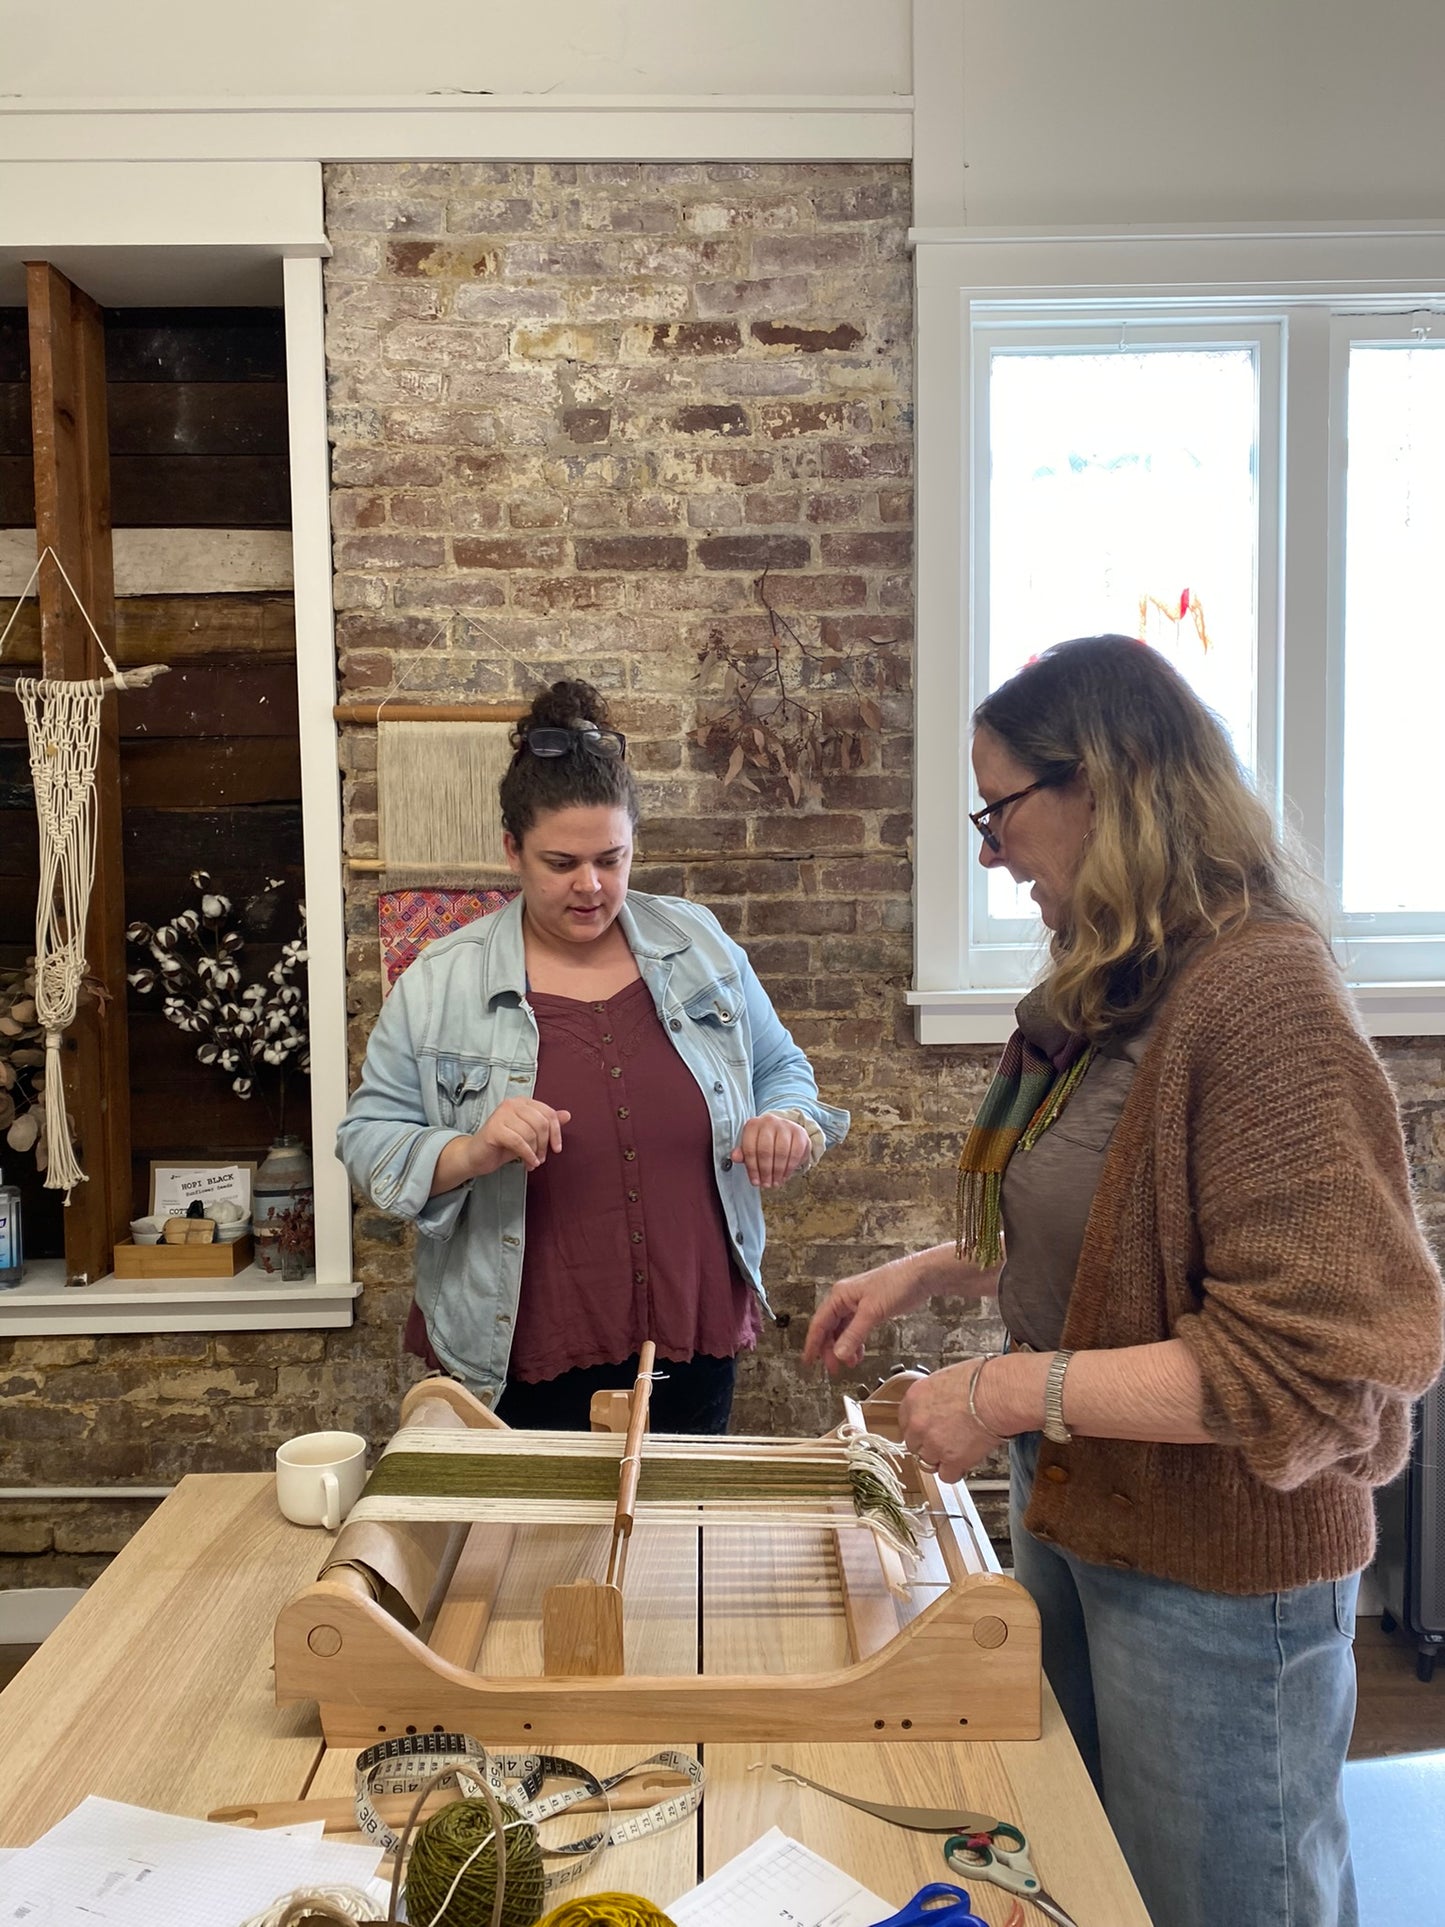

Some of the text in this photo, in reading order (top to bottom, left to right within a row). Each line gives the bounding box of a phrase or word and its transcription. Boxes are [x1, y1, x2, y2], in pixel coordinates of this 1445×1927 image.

[181, 1173, 234, 1191] HOPI BLACK
[186, 1187, 214, 1196] Sunflower
